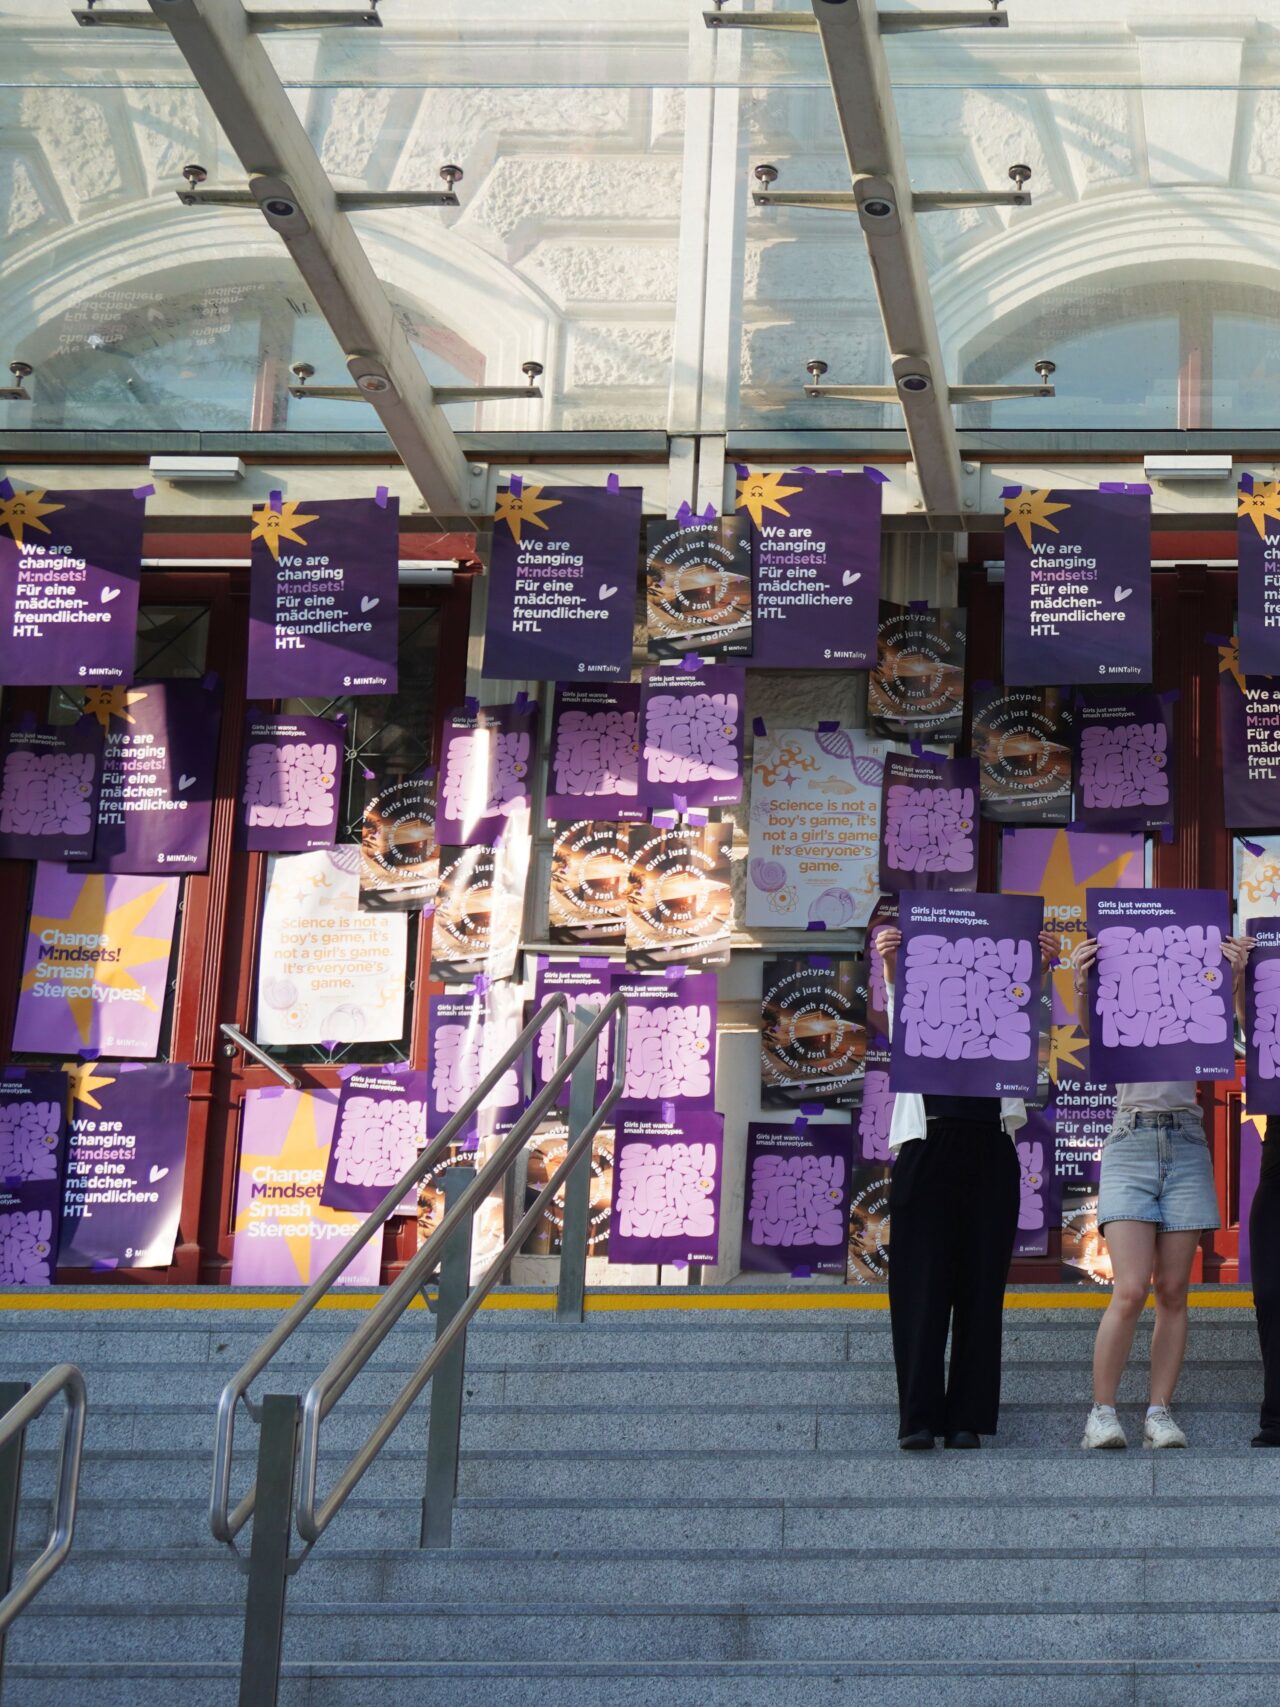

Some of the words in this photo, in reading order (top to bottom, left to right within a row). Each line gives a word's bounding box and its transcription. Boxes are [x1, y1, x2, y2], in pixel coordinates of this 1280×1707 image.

[761, 527, 785, 537] We
[789, 528, 812, 537] are
[20, 544, 45, 556] We
[48, 546, 72, 555] are
[760, 539, 826, 553] changing
[18, 556, 86, 570] changing
[760, 553, 826, 564] M:ndsets!
[18, 570, 86, 582] M:ndsets!
[759, 566, 783, 578] Für
[786, 566, 817, 578] eine
[16, 584, 42, 596] Für
[44, 584, 76, 595] eine
[758, 580, 830, 591] mädchen-
[15, 597, 88, 609] mädchen-
[758, 594, 853, 605] freundlichere
[14, 610, 111, 623] freundlichere
[758, 608, 786, 618] HTL
[13, 625, 43, 636] HTL
[834, 651, 866, 659] MINTality
[89, 668, 122, 676] MINTality
[107, 734, 130, 744] We
[133, 734, 154, 744] are
[105, 745, 165, 759] changing
[104, 760, 166, 770] M:ndsets!
[102, 773, 126, 784] Für
[128, 772, 156, 784] eine
[101, 786, 167, 797] mädchen-
[100, 798, 188, 811] freundlichere
[770, 800, 824, 811] Science
[827, 800, 838, 811] is
[842, 800, 865, 811] not
[868, 803, 876, 811] a
[98, 813, 125, 824] HTL
[768, 814, 806, 828] boy's
[810, 816, 853, 828] game,
[856, 812, 876, 826] it's
[762, 830, 786, 840] not
[802, 830, 834, 843] girl's
[771, 845, 793, 857] It's
[795, 846, 872, 858] everyone's
[166, 855, 197, 863] MINTality
[799, 861, 842, 873] game.
[1118, 901, 1133, 910] just
[932, 907, 946, 917] just
[1126, 908, 1176, 916] stereotypes.
[911, 913, 936, 922] smash
[938, 916, 989, 926] stereotypes.
[39, 930, 110, 948] Change
[40, 946, 120, 961] M:ndsets!
[35, 962, 94, 979] Smash
[778, 969, 835, 987] stereotypes
[32, 982, 146, 1002] Stereotypes!
[780, 991, 800, 1009] Girls
[803, 986, 821, 996] just
[825, 987, 851, 1009] wanna
[792, 1002, 816, 1022] smash
[808, 1050, 826, 1058] just
[775, 1045, 799, 1068] smash
[802, 1046, 856, 1074] stereotypes
[1003, 1084, 1029, 1092] MINTality
[72, 1120, 96, 1132] We
[99, 1122, 122, 1132] are
[70, 1133, 136, 1148] changing
[70, 1148, 136, 1160] M:ndsets!
[68, 1162, 92, 1174] Für
[94, 1162, 125, 1174] eine
[66, 1176, 137, 1188] mädchen-
[65, 1190, 158, 1203] freundlichere
[64, 1204, 92, 1217] HTL
